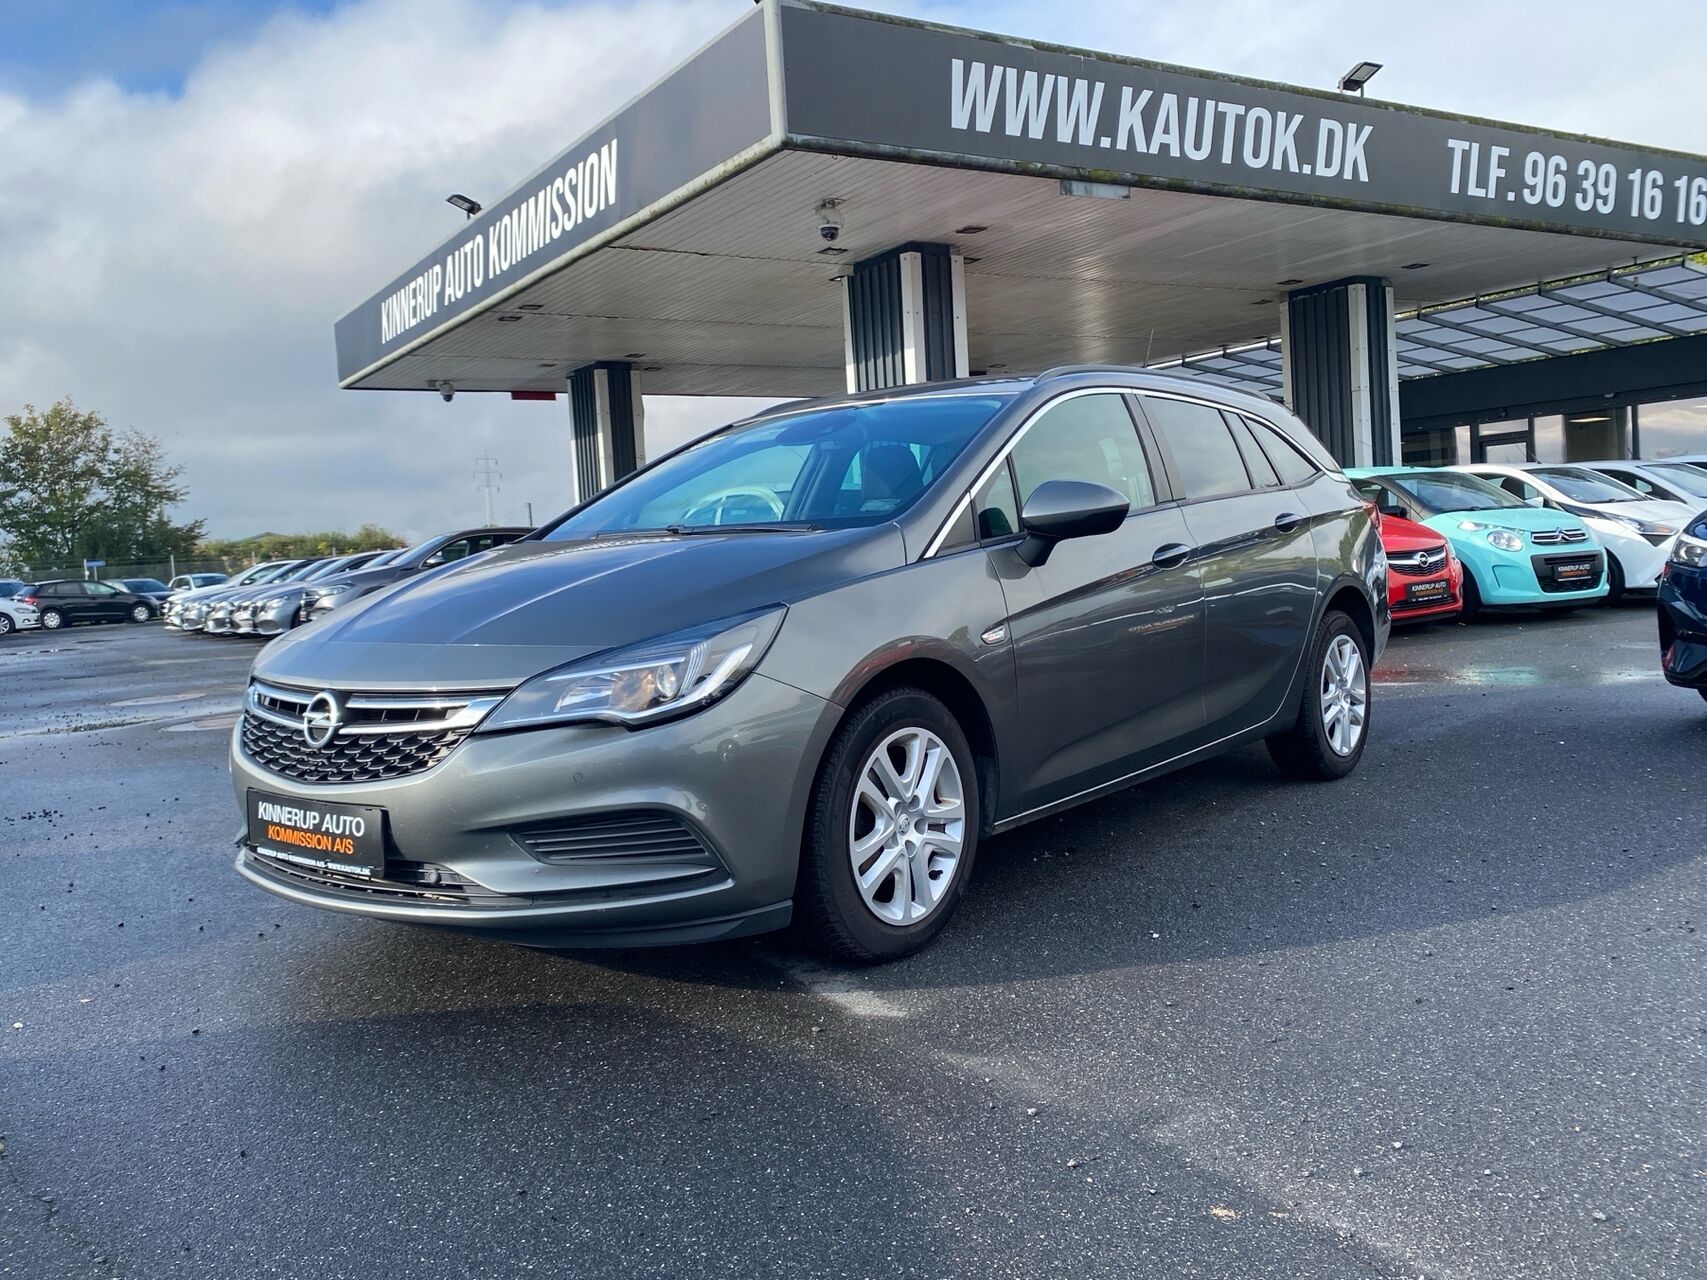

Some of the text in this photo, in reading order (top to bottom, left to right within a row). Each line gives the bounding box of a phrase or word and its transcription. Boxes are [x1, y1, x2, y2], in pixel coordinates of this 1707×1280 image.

[950, 57, 1375, 183] WWW.KAUTOK.DK
[1447, 138, 1707, 226] TLF. 96 39 16 16
[380, 138, 618, 345] KINNERUP AUTO KOMMISSION
[257, 801, 366, 837] KINNERUP AUTO
[268, 825, 354, 855] KOMMISSION A/S
